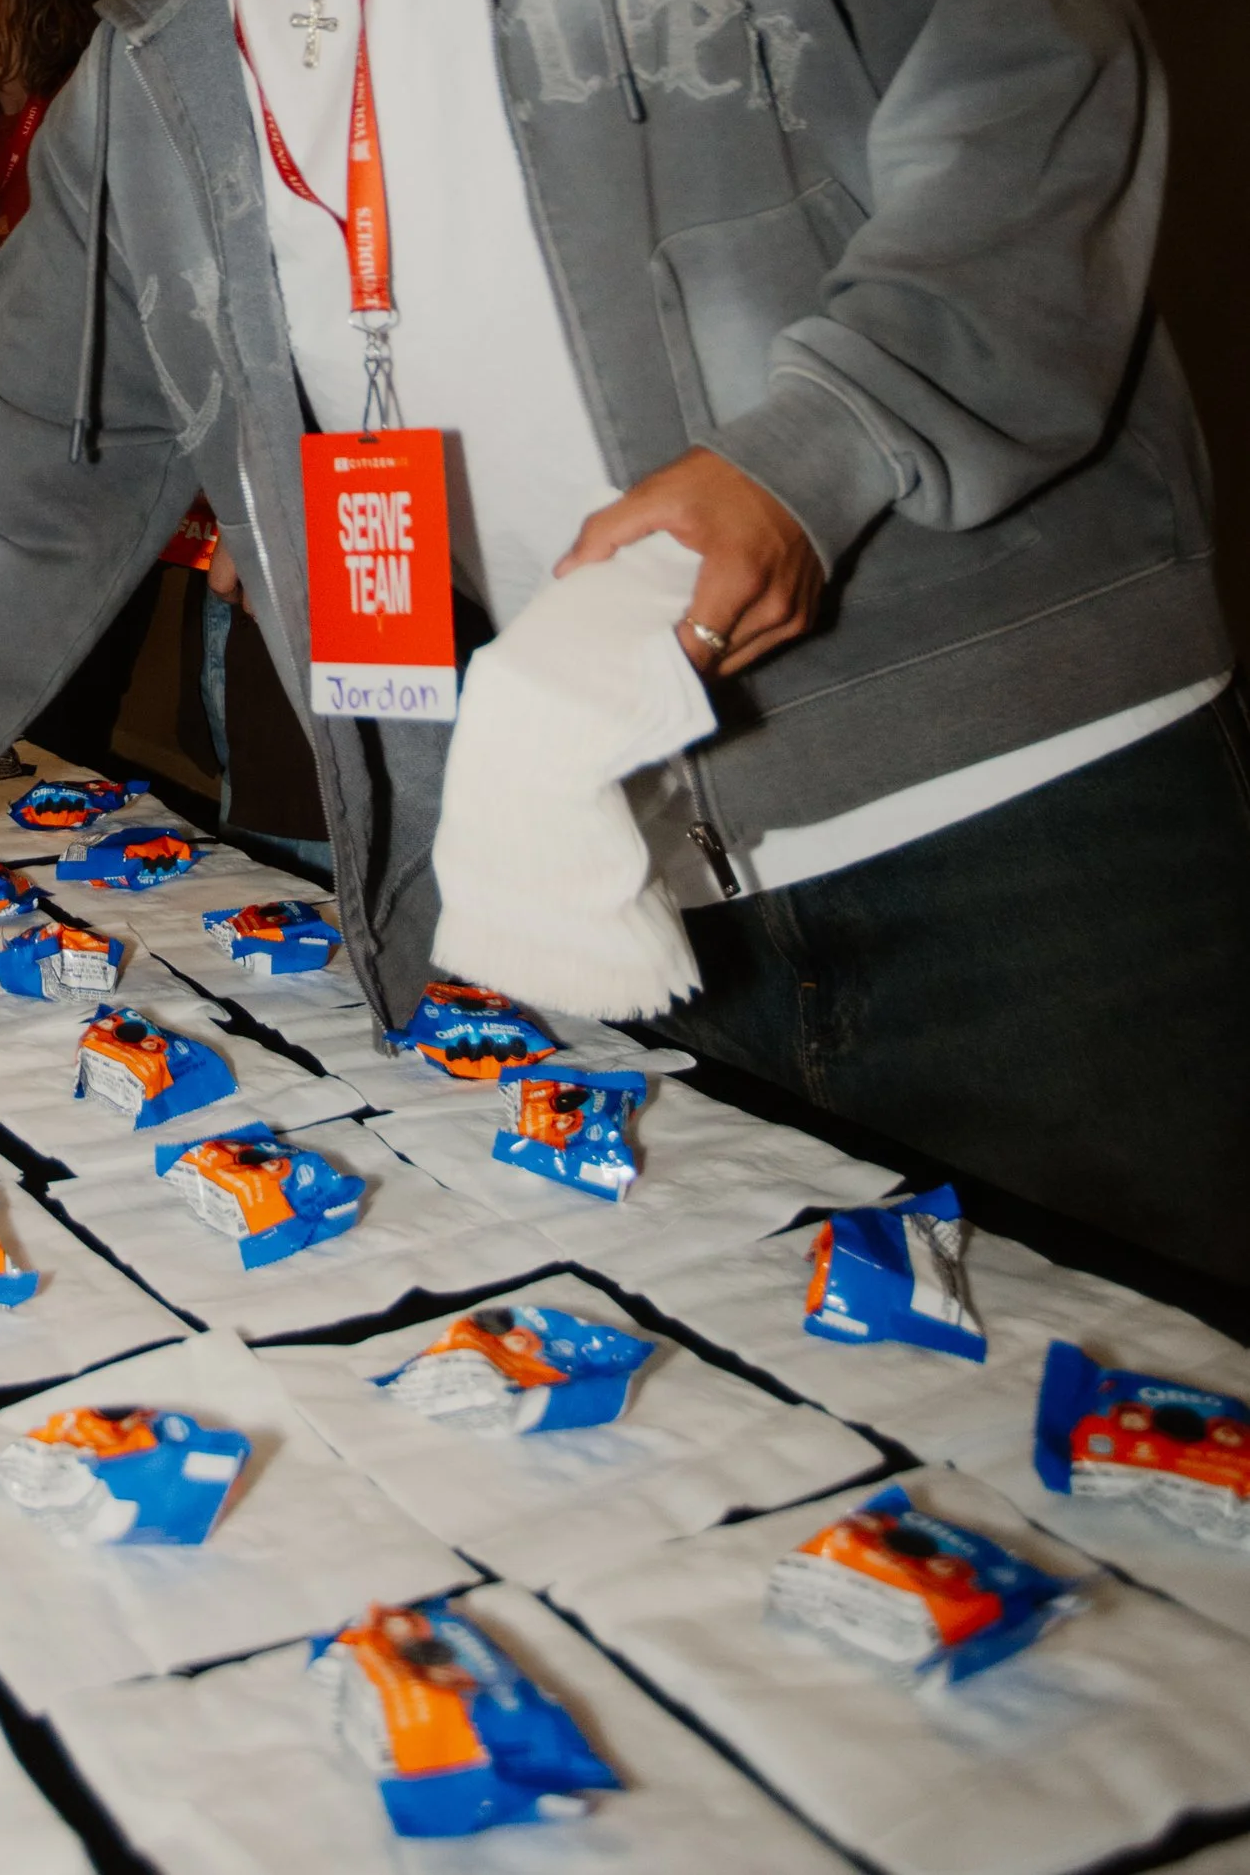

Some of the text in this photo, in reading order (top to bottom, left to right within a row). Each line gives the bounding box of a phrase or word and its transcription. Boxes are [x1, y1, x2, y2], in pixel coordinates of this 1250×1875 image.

[337, 491, 414, 552] SERVE
[345, 555, 412, 615] TEAM
[326, 676, 438, 712] Jordan
